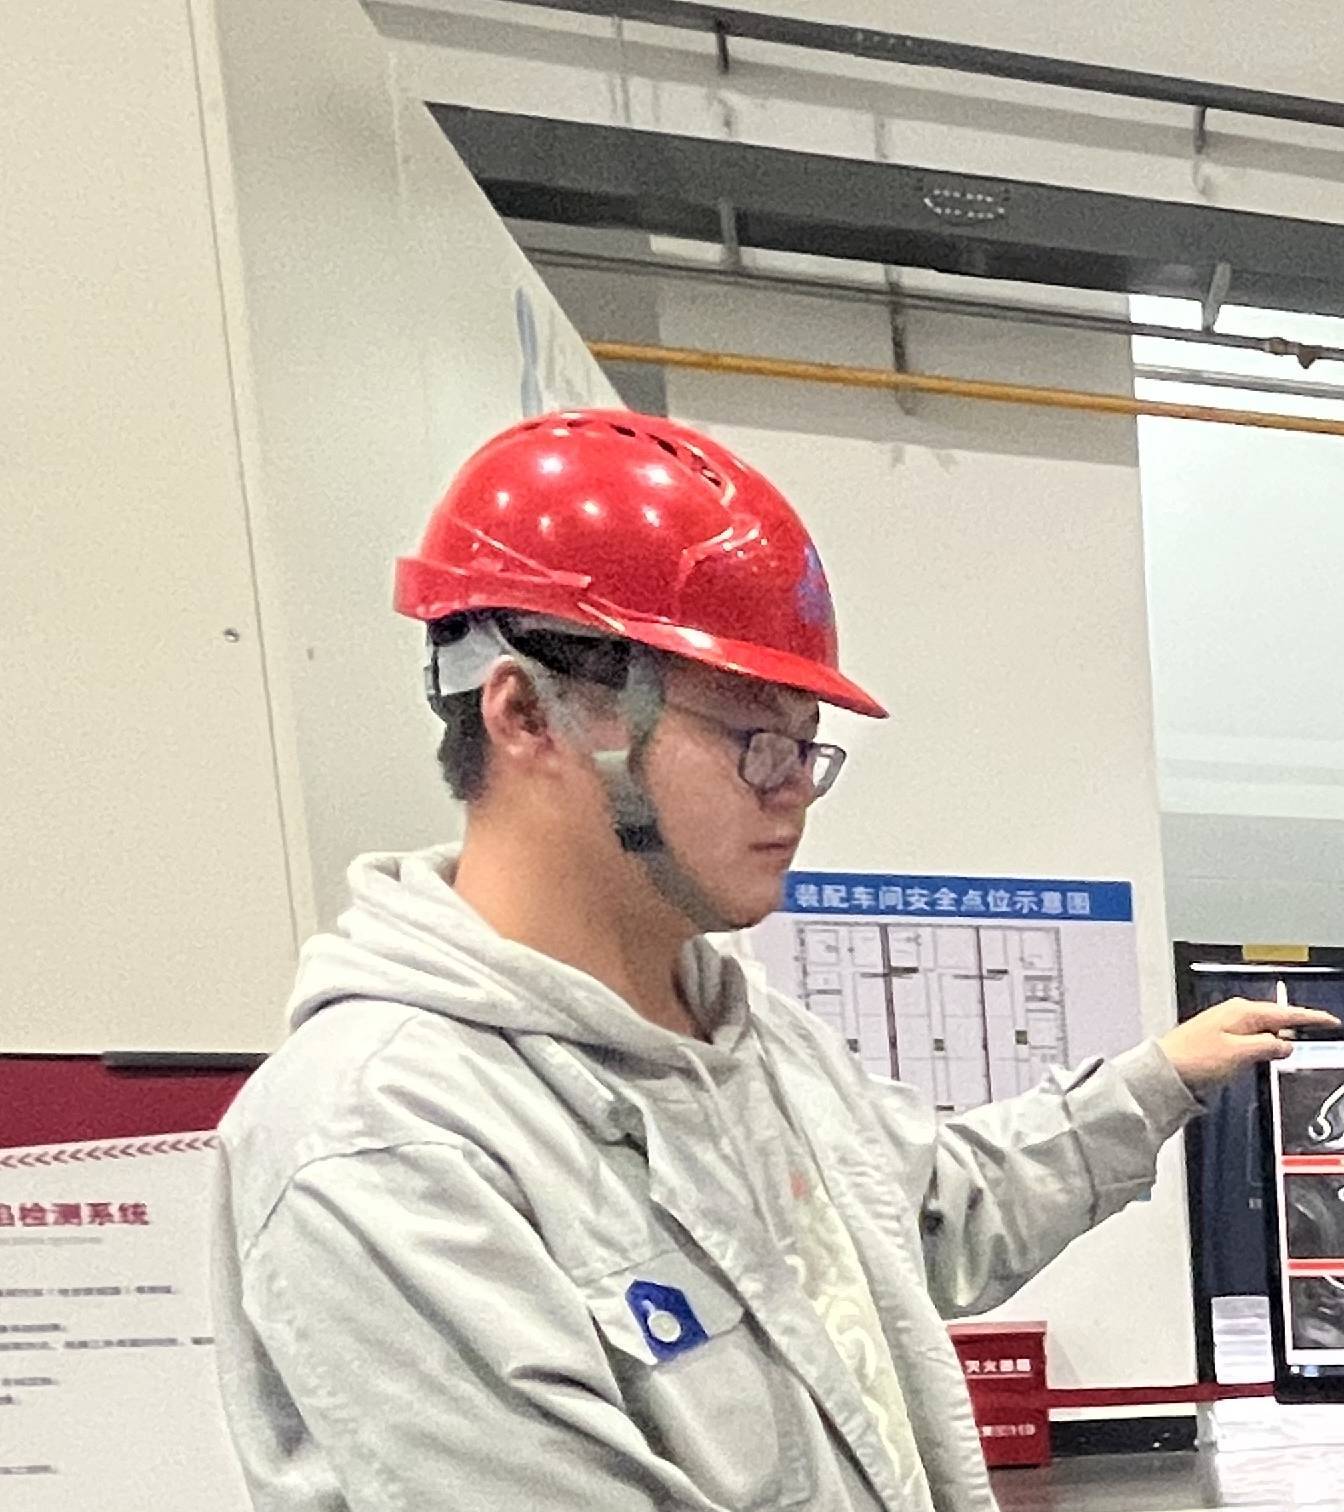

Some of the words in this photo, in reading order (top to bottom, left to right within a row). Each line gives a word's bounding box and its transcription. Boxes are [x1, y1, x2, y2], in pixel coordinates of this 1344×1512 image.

[794, 883, 1092, 916] 装配车间安全点位示意图
